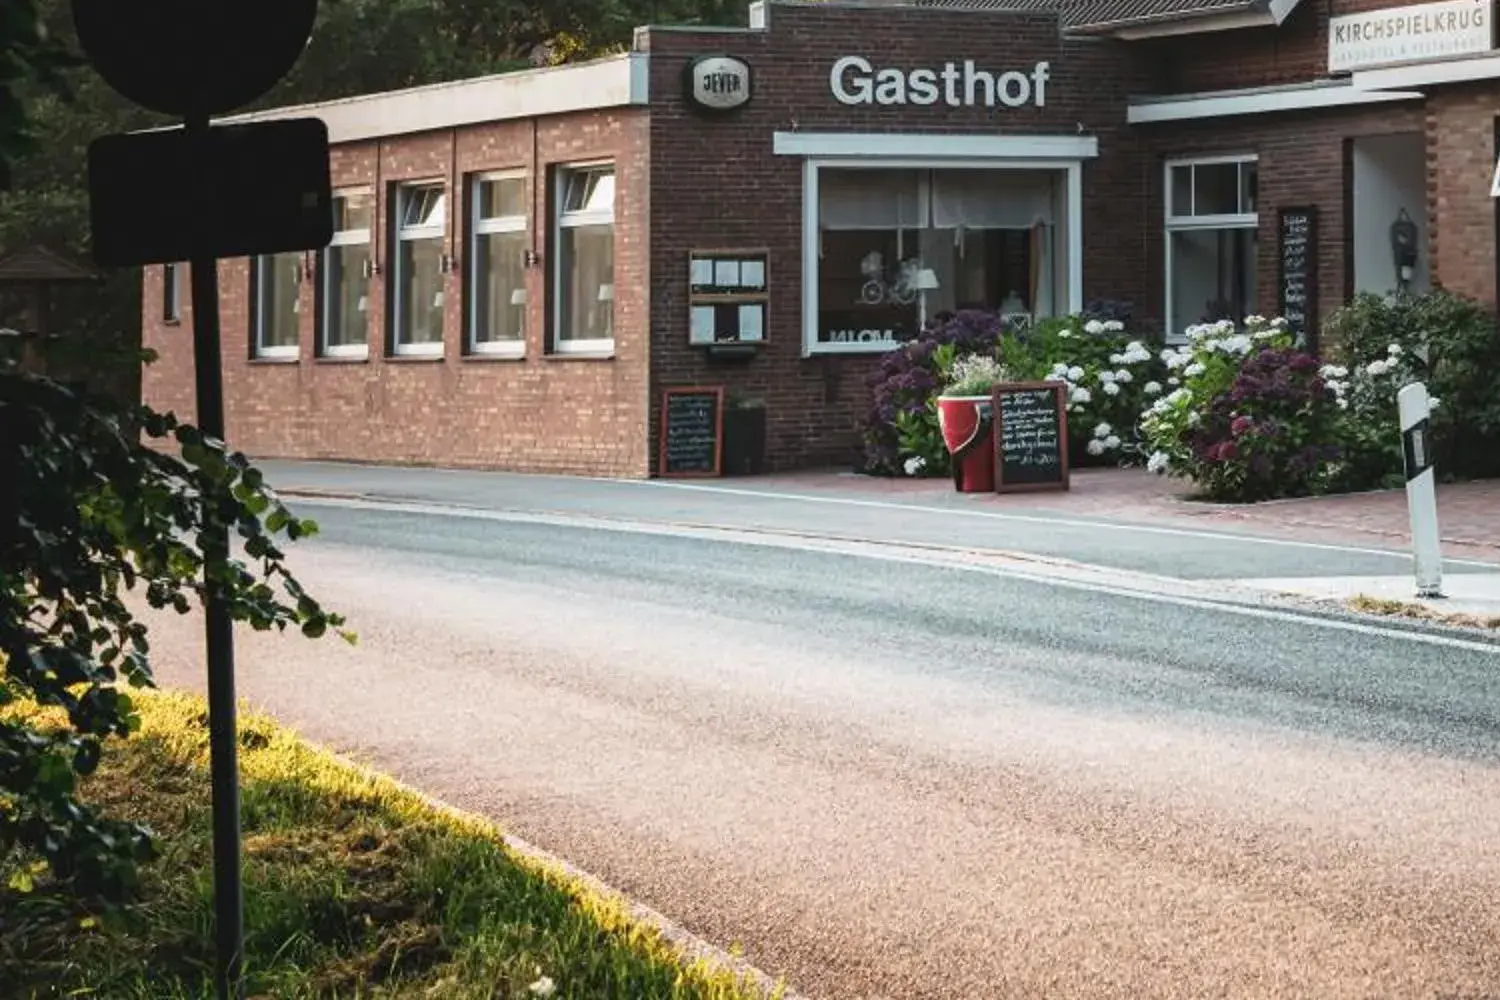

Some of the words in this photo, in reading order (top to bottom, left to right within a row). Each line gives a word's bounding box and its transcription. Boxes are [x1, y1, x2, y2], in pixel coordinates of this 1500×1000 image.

[1335, 8, 1484, 44] KIRCHSPIELKRUG
[703, 72, 741, 93] JEVER
[830, 55, 1050, 107] Gasthof
